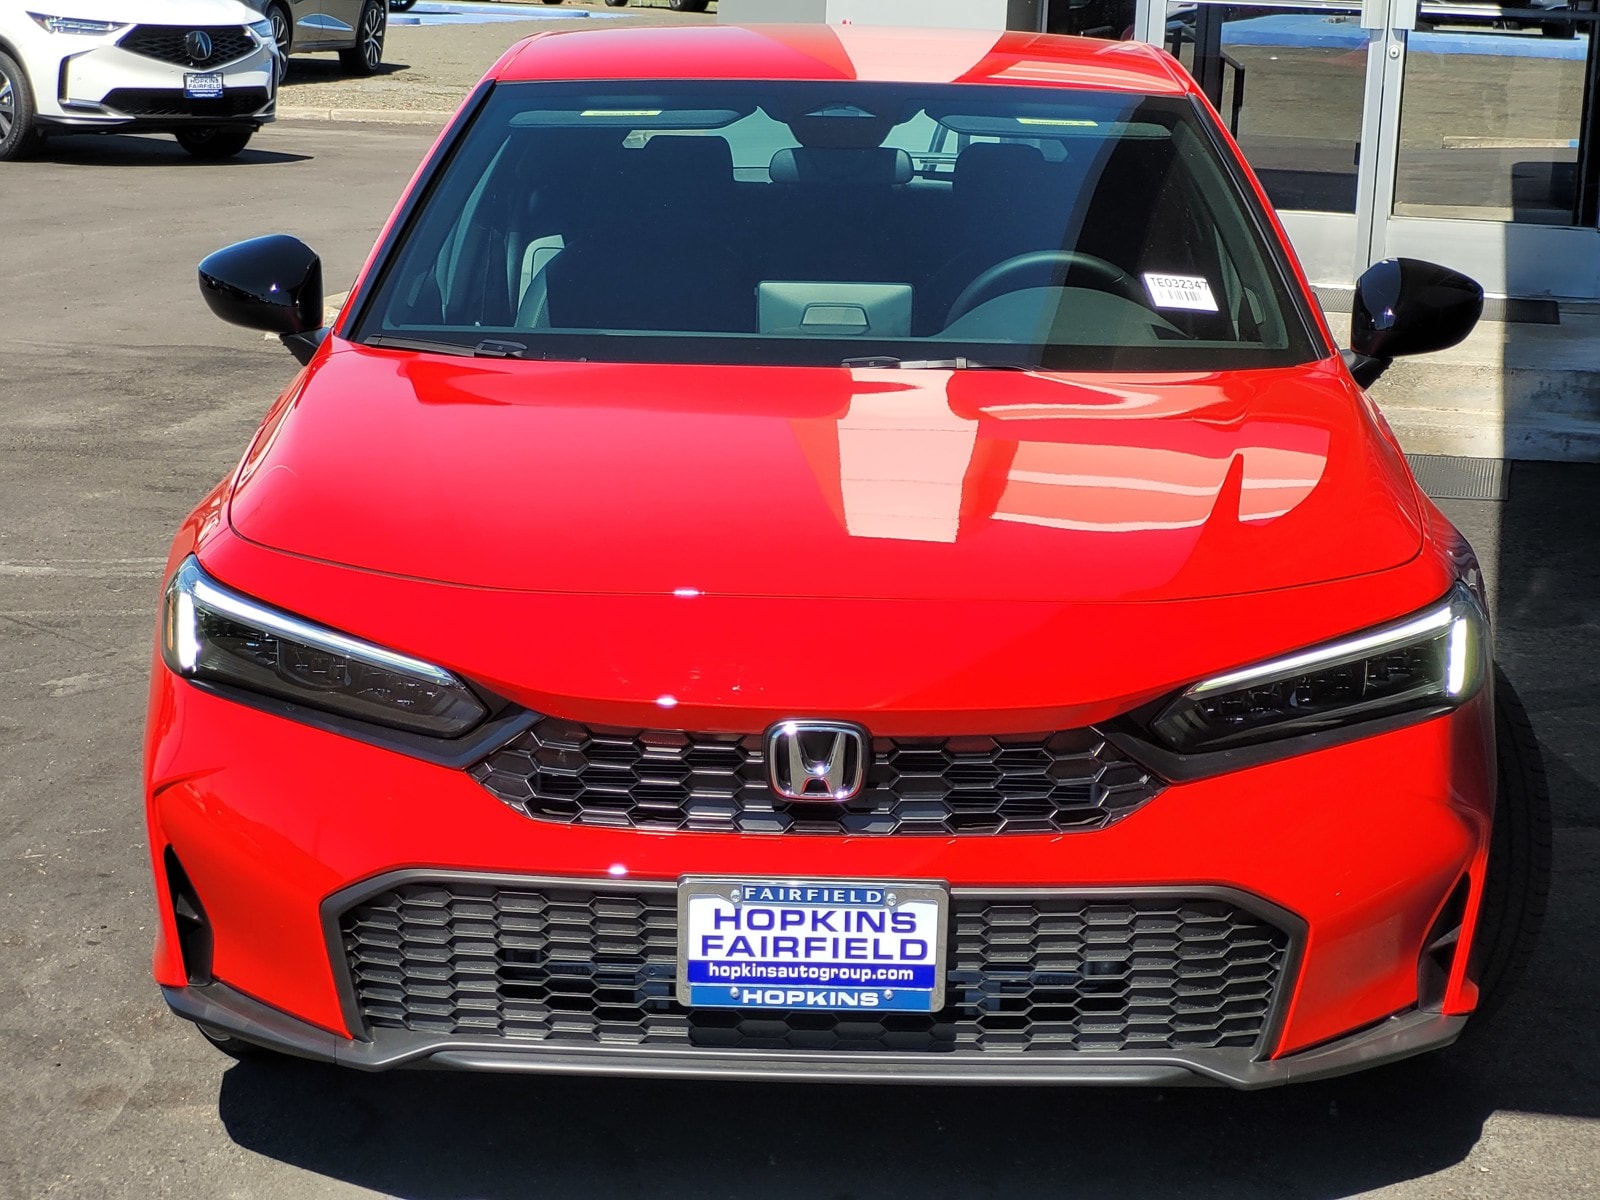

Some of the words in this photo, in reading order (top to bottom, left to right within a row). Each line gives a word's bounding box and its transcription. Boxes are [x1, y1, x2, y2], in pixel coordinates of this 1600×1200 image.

[1150, 277, 1208, 290] TE032347
[745, 887, 882, 903] FAIRFIELD
[713, 908, 917, 934] HOPKINS
[701, 935, 928, 961] FAIRFIELD
[709, 963, 914, 981] hopkinsautogroup.com
[743, 989, 879, 1006] HOPKINS
